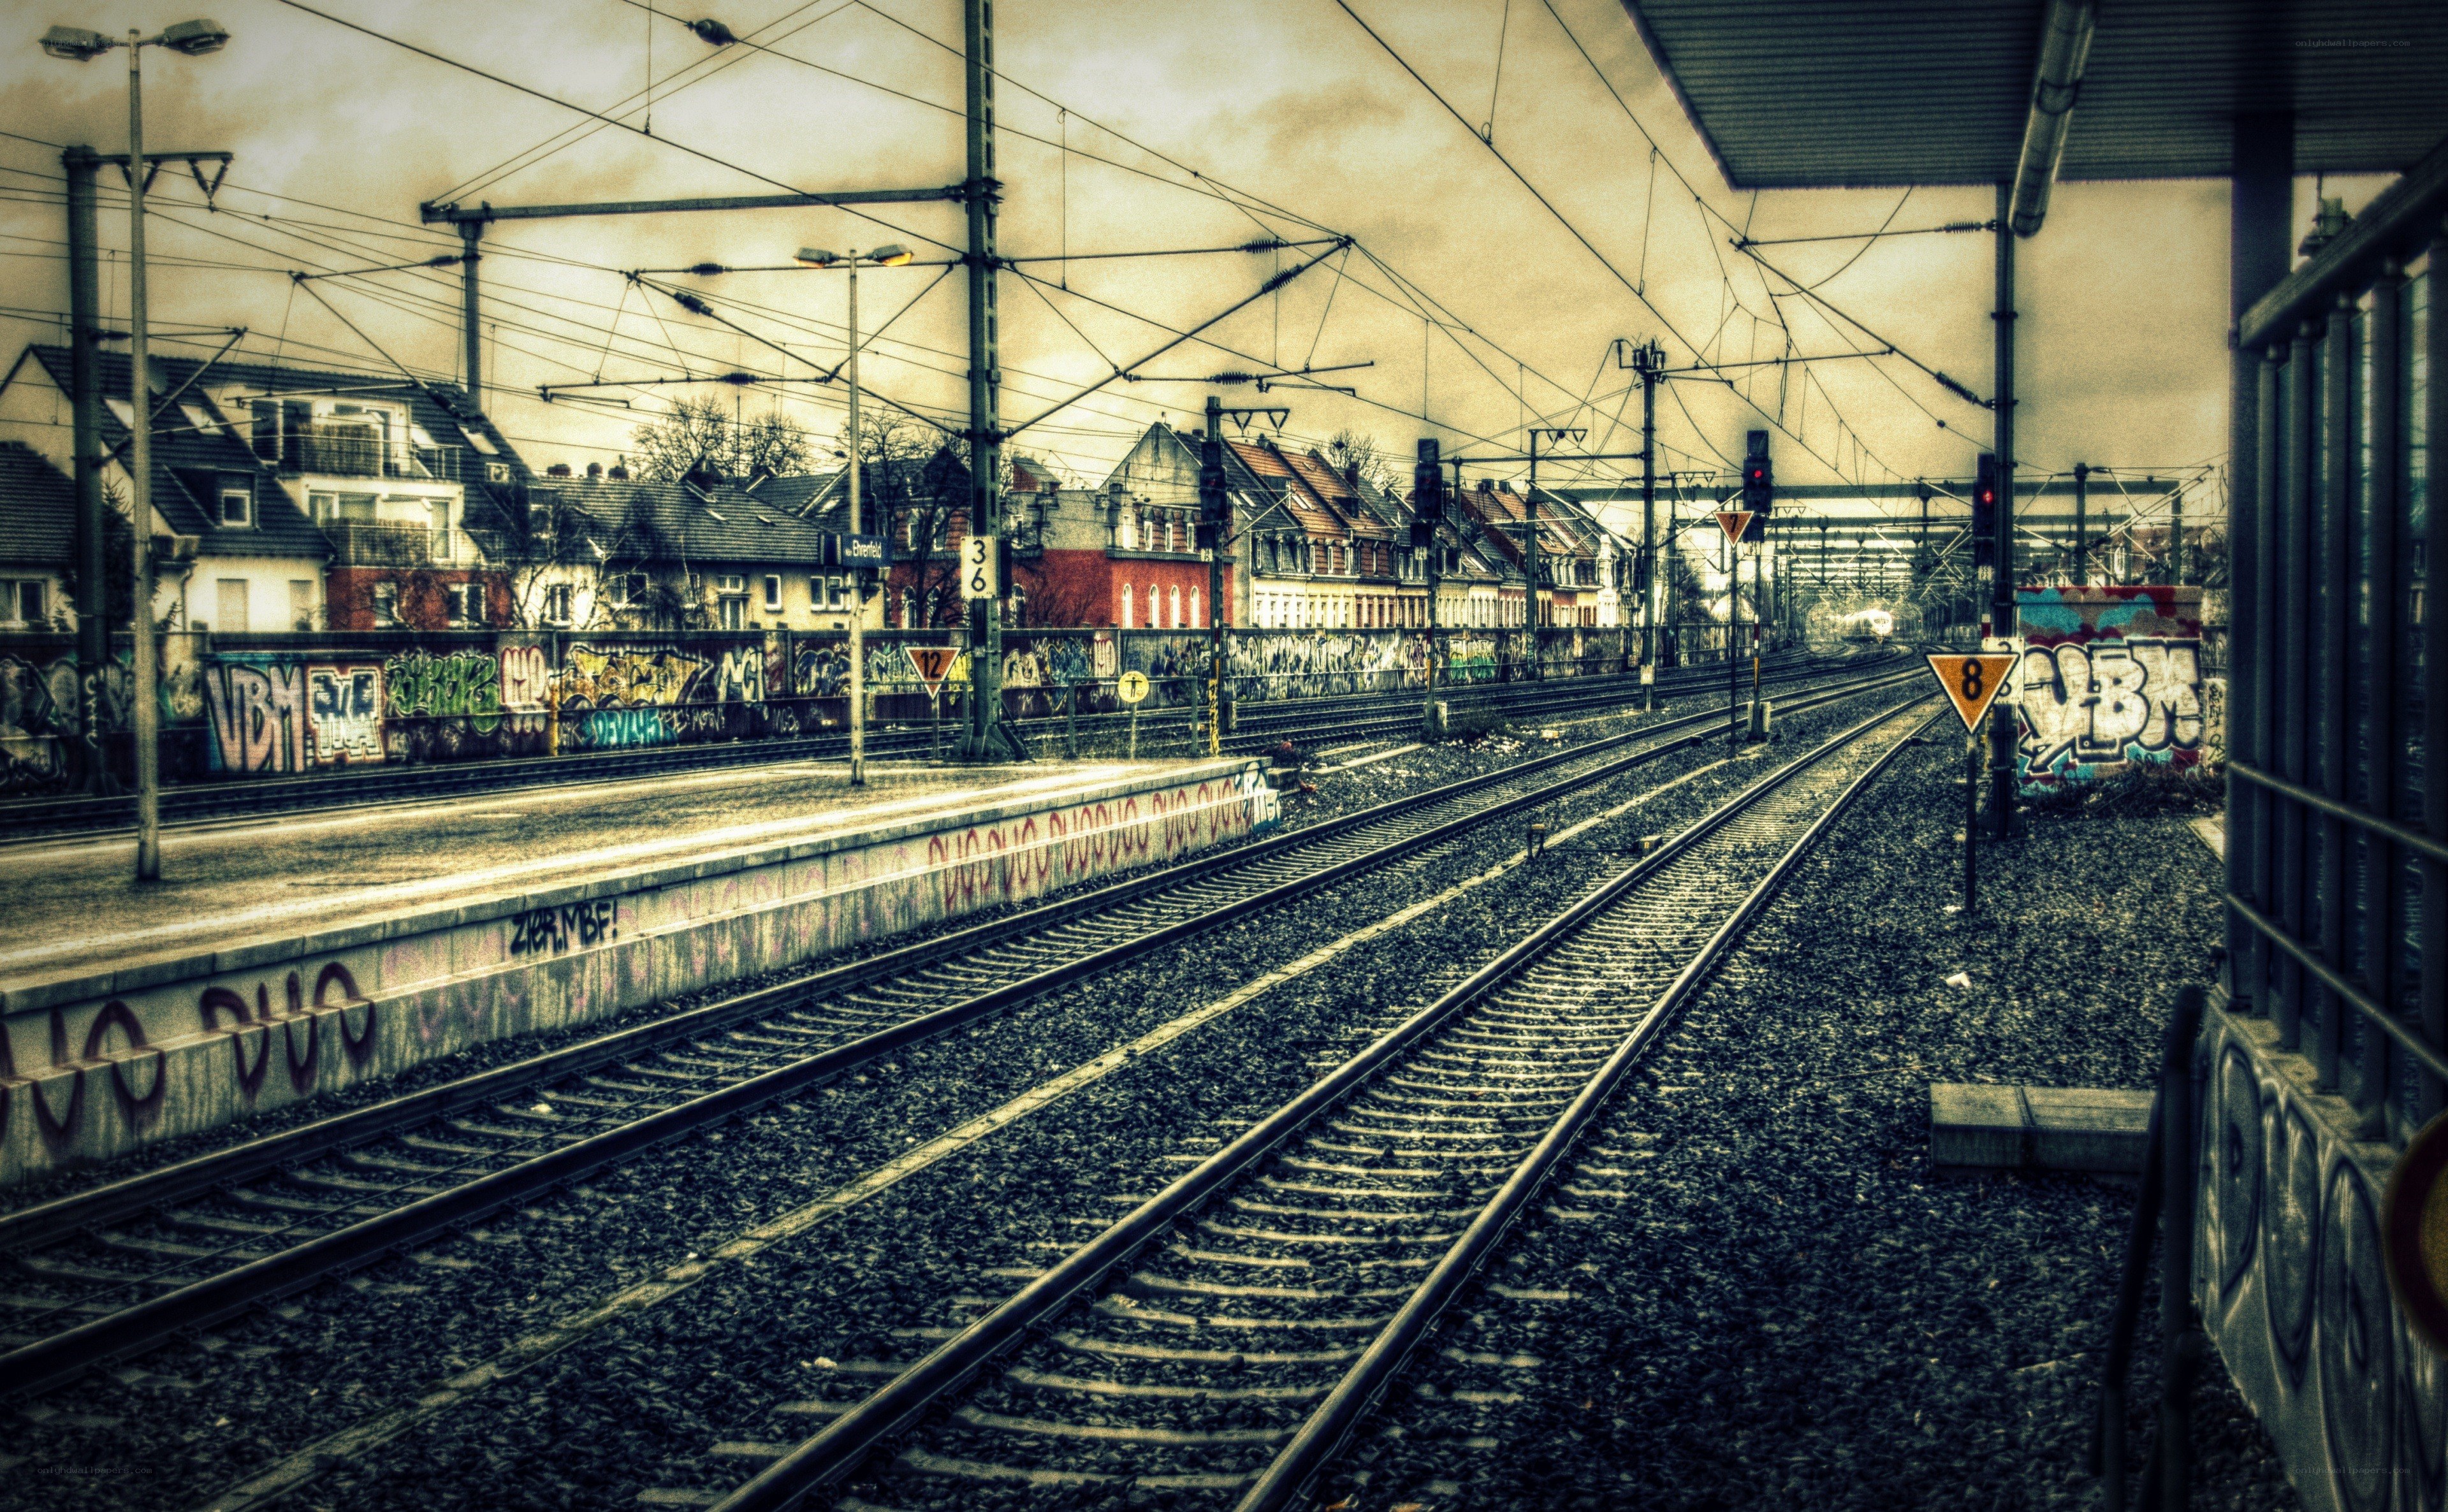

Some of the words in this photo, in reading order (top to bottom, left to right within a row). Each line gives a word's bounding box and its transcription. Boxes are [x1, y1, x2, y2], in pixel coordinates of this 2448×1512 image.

[1730, 513, 1738, 533] 7
[852, 539, 882, 559] Ehrenfeld
[972, 539, 986, 565] 3
[971, 567, 986, 592] 6
[921, 651, 942, 678] 12
[1962, 657, 1983, 701] 8
[205, 663, 305, 773] VBM
